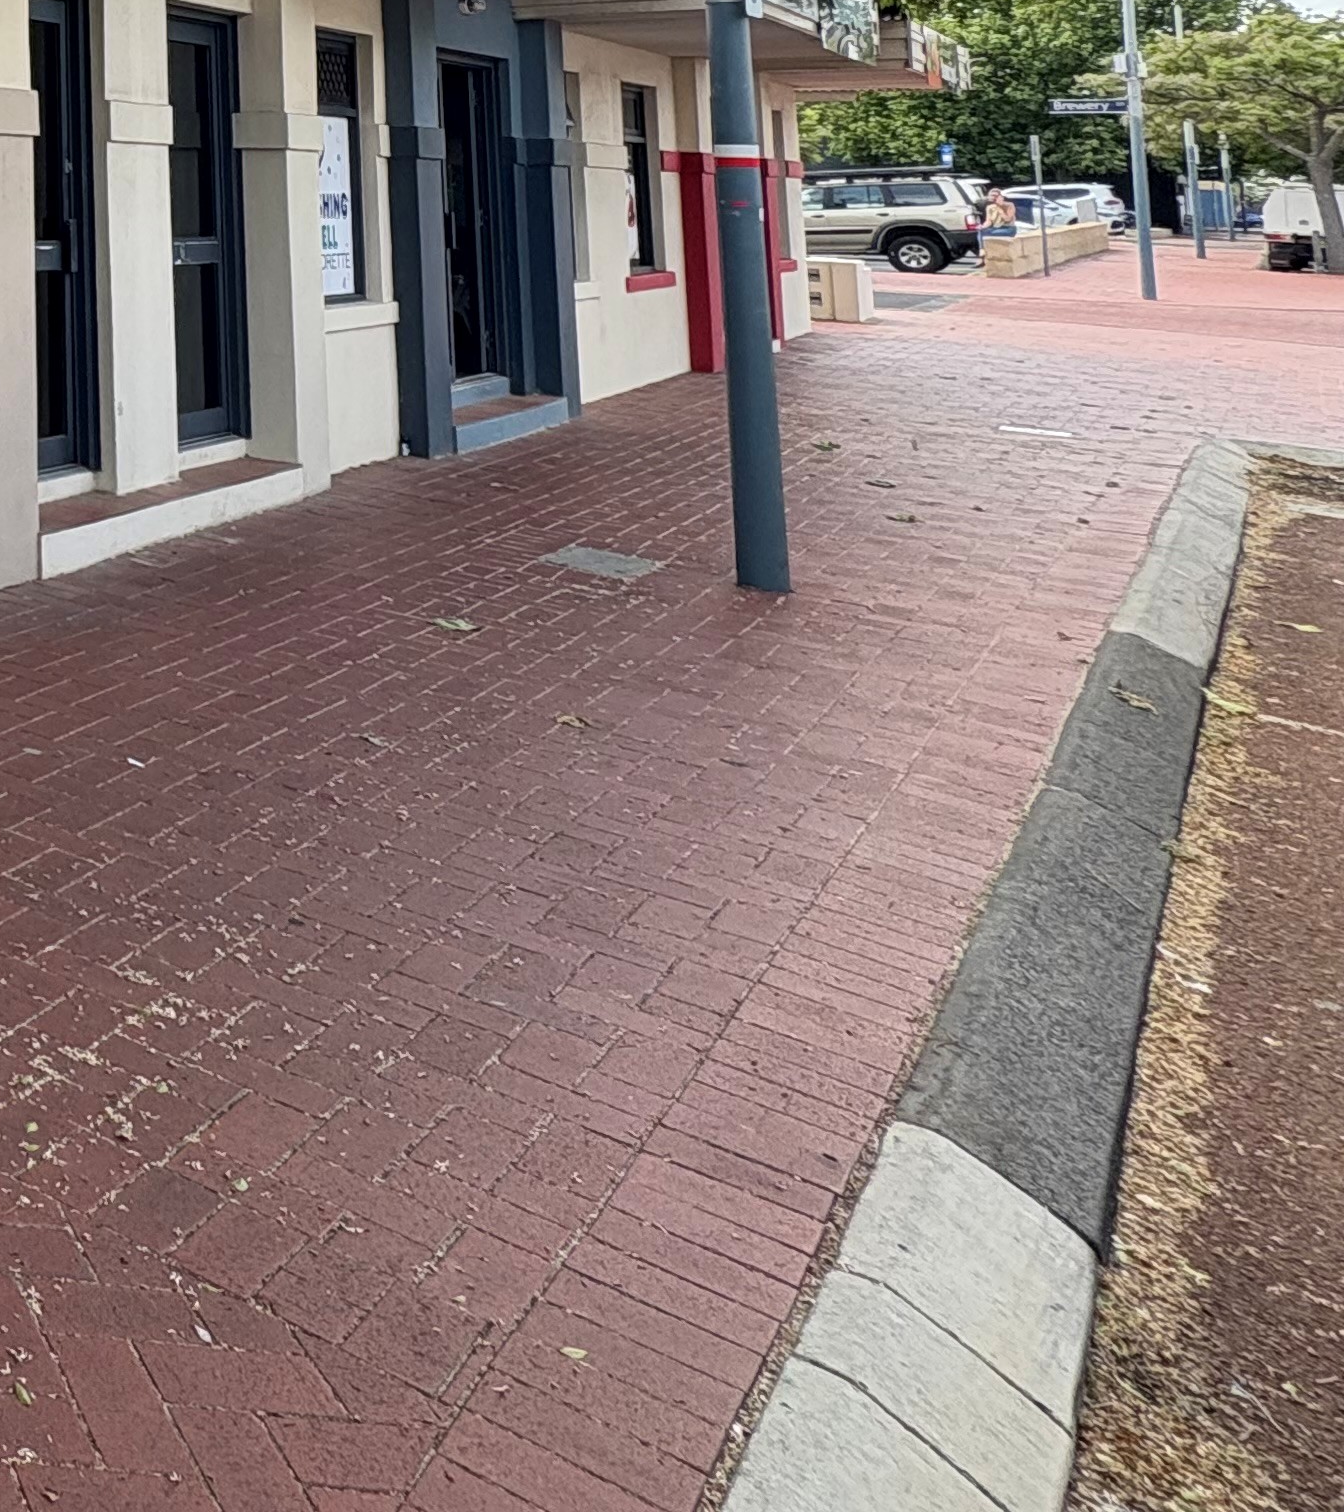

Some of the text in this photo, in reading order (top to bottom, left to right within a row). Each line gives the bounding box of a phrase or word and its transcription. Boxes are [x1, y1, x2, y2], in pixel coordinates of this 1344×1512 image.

[1053, 100, 1110, 112] Brewery
[319, 192, 348, 220] HING
[321, 224, 339, 250] ELL
